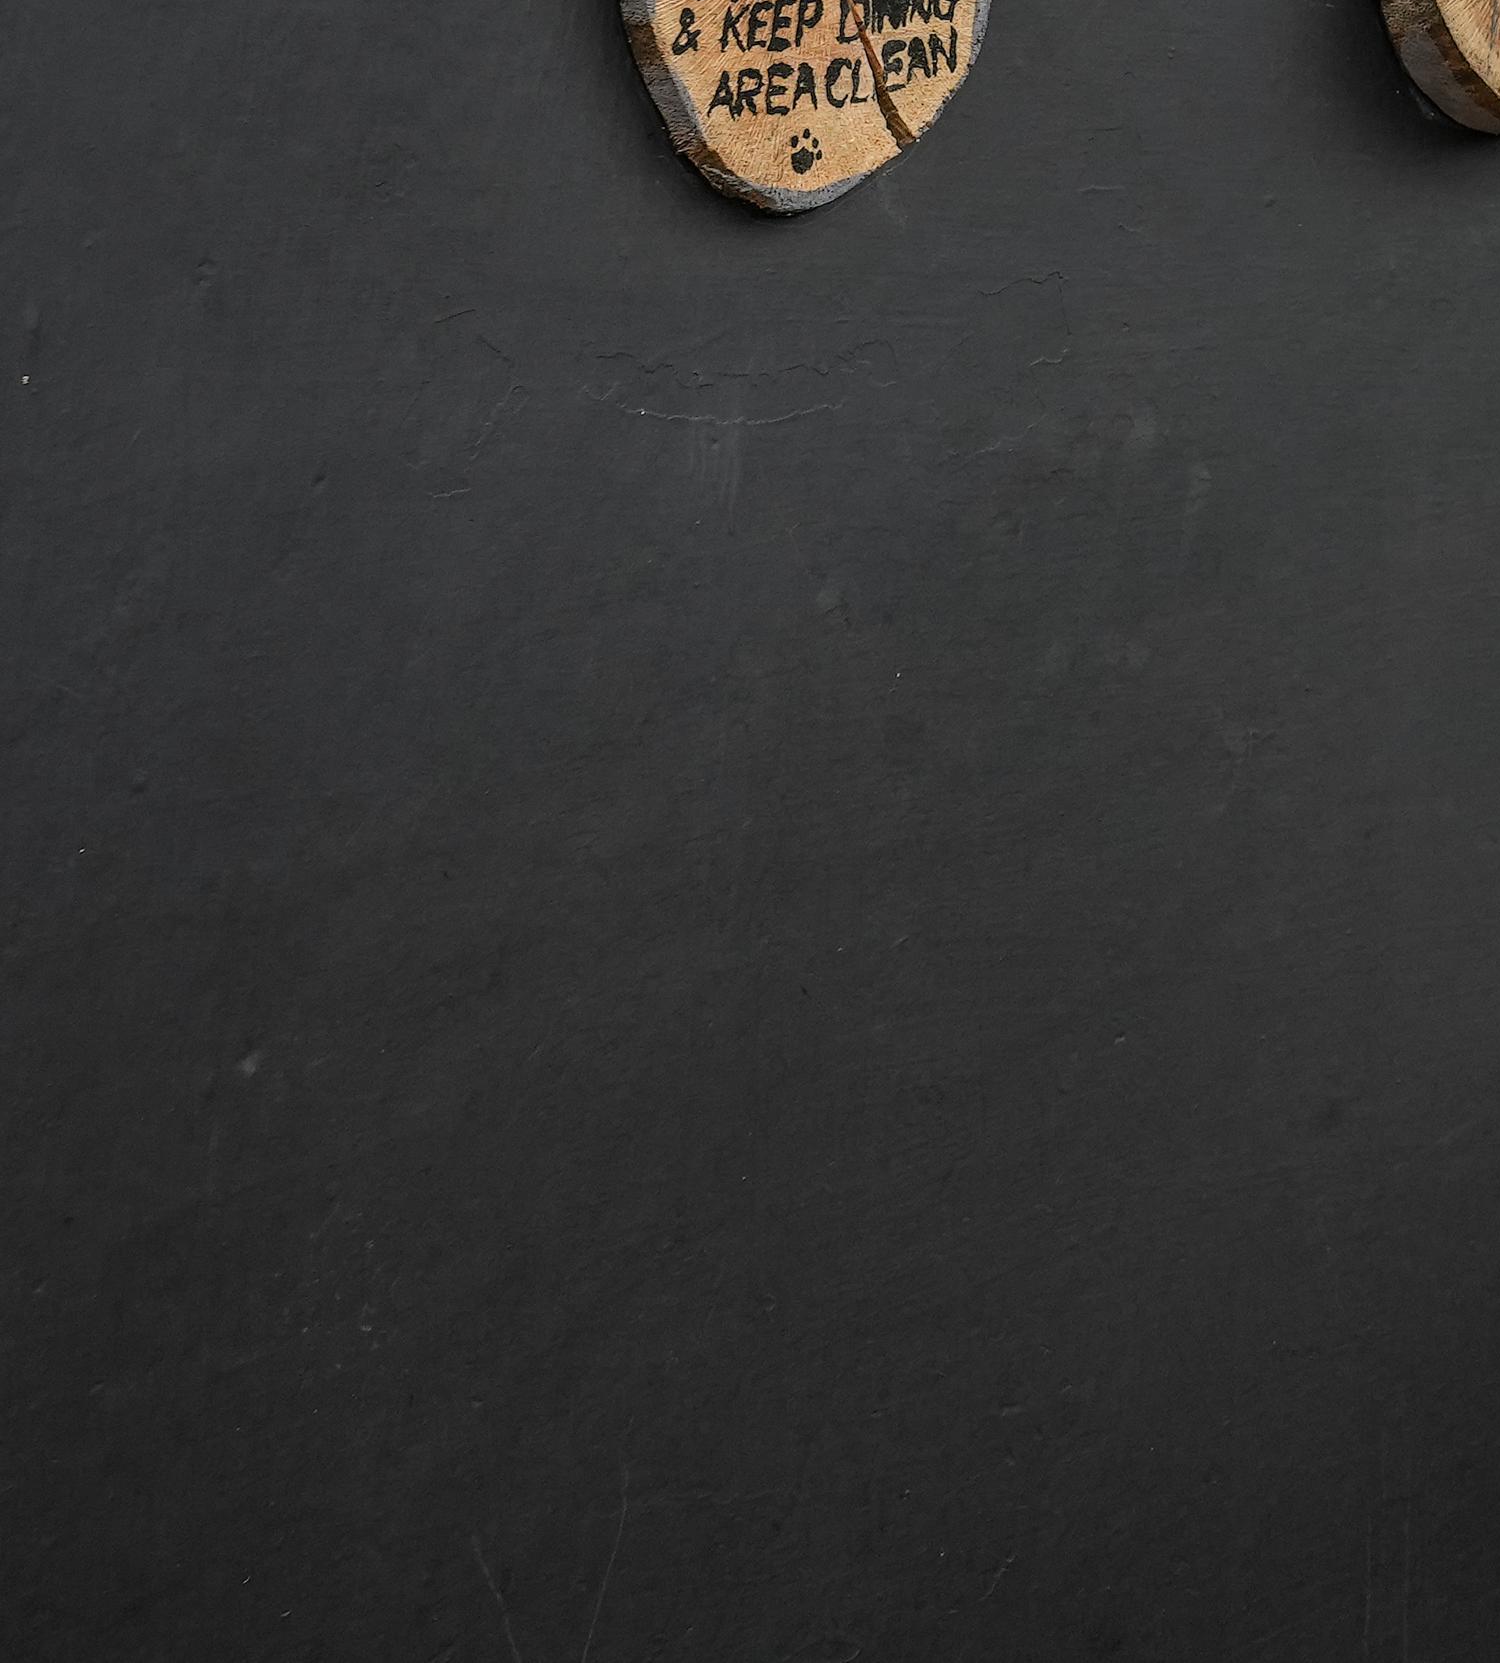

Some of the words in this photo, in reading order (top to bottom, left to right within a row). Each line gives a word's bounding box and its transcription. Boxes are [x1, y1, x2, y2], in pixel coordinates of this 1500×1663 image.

[672, 7, 700, 56] &
[707, 59, 818, 122] AREA
[824, 24, 958, 109] CLEAN
